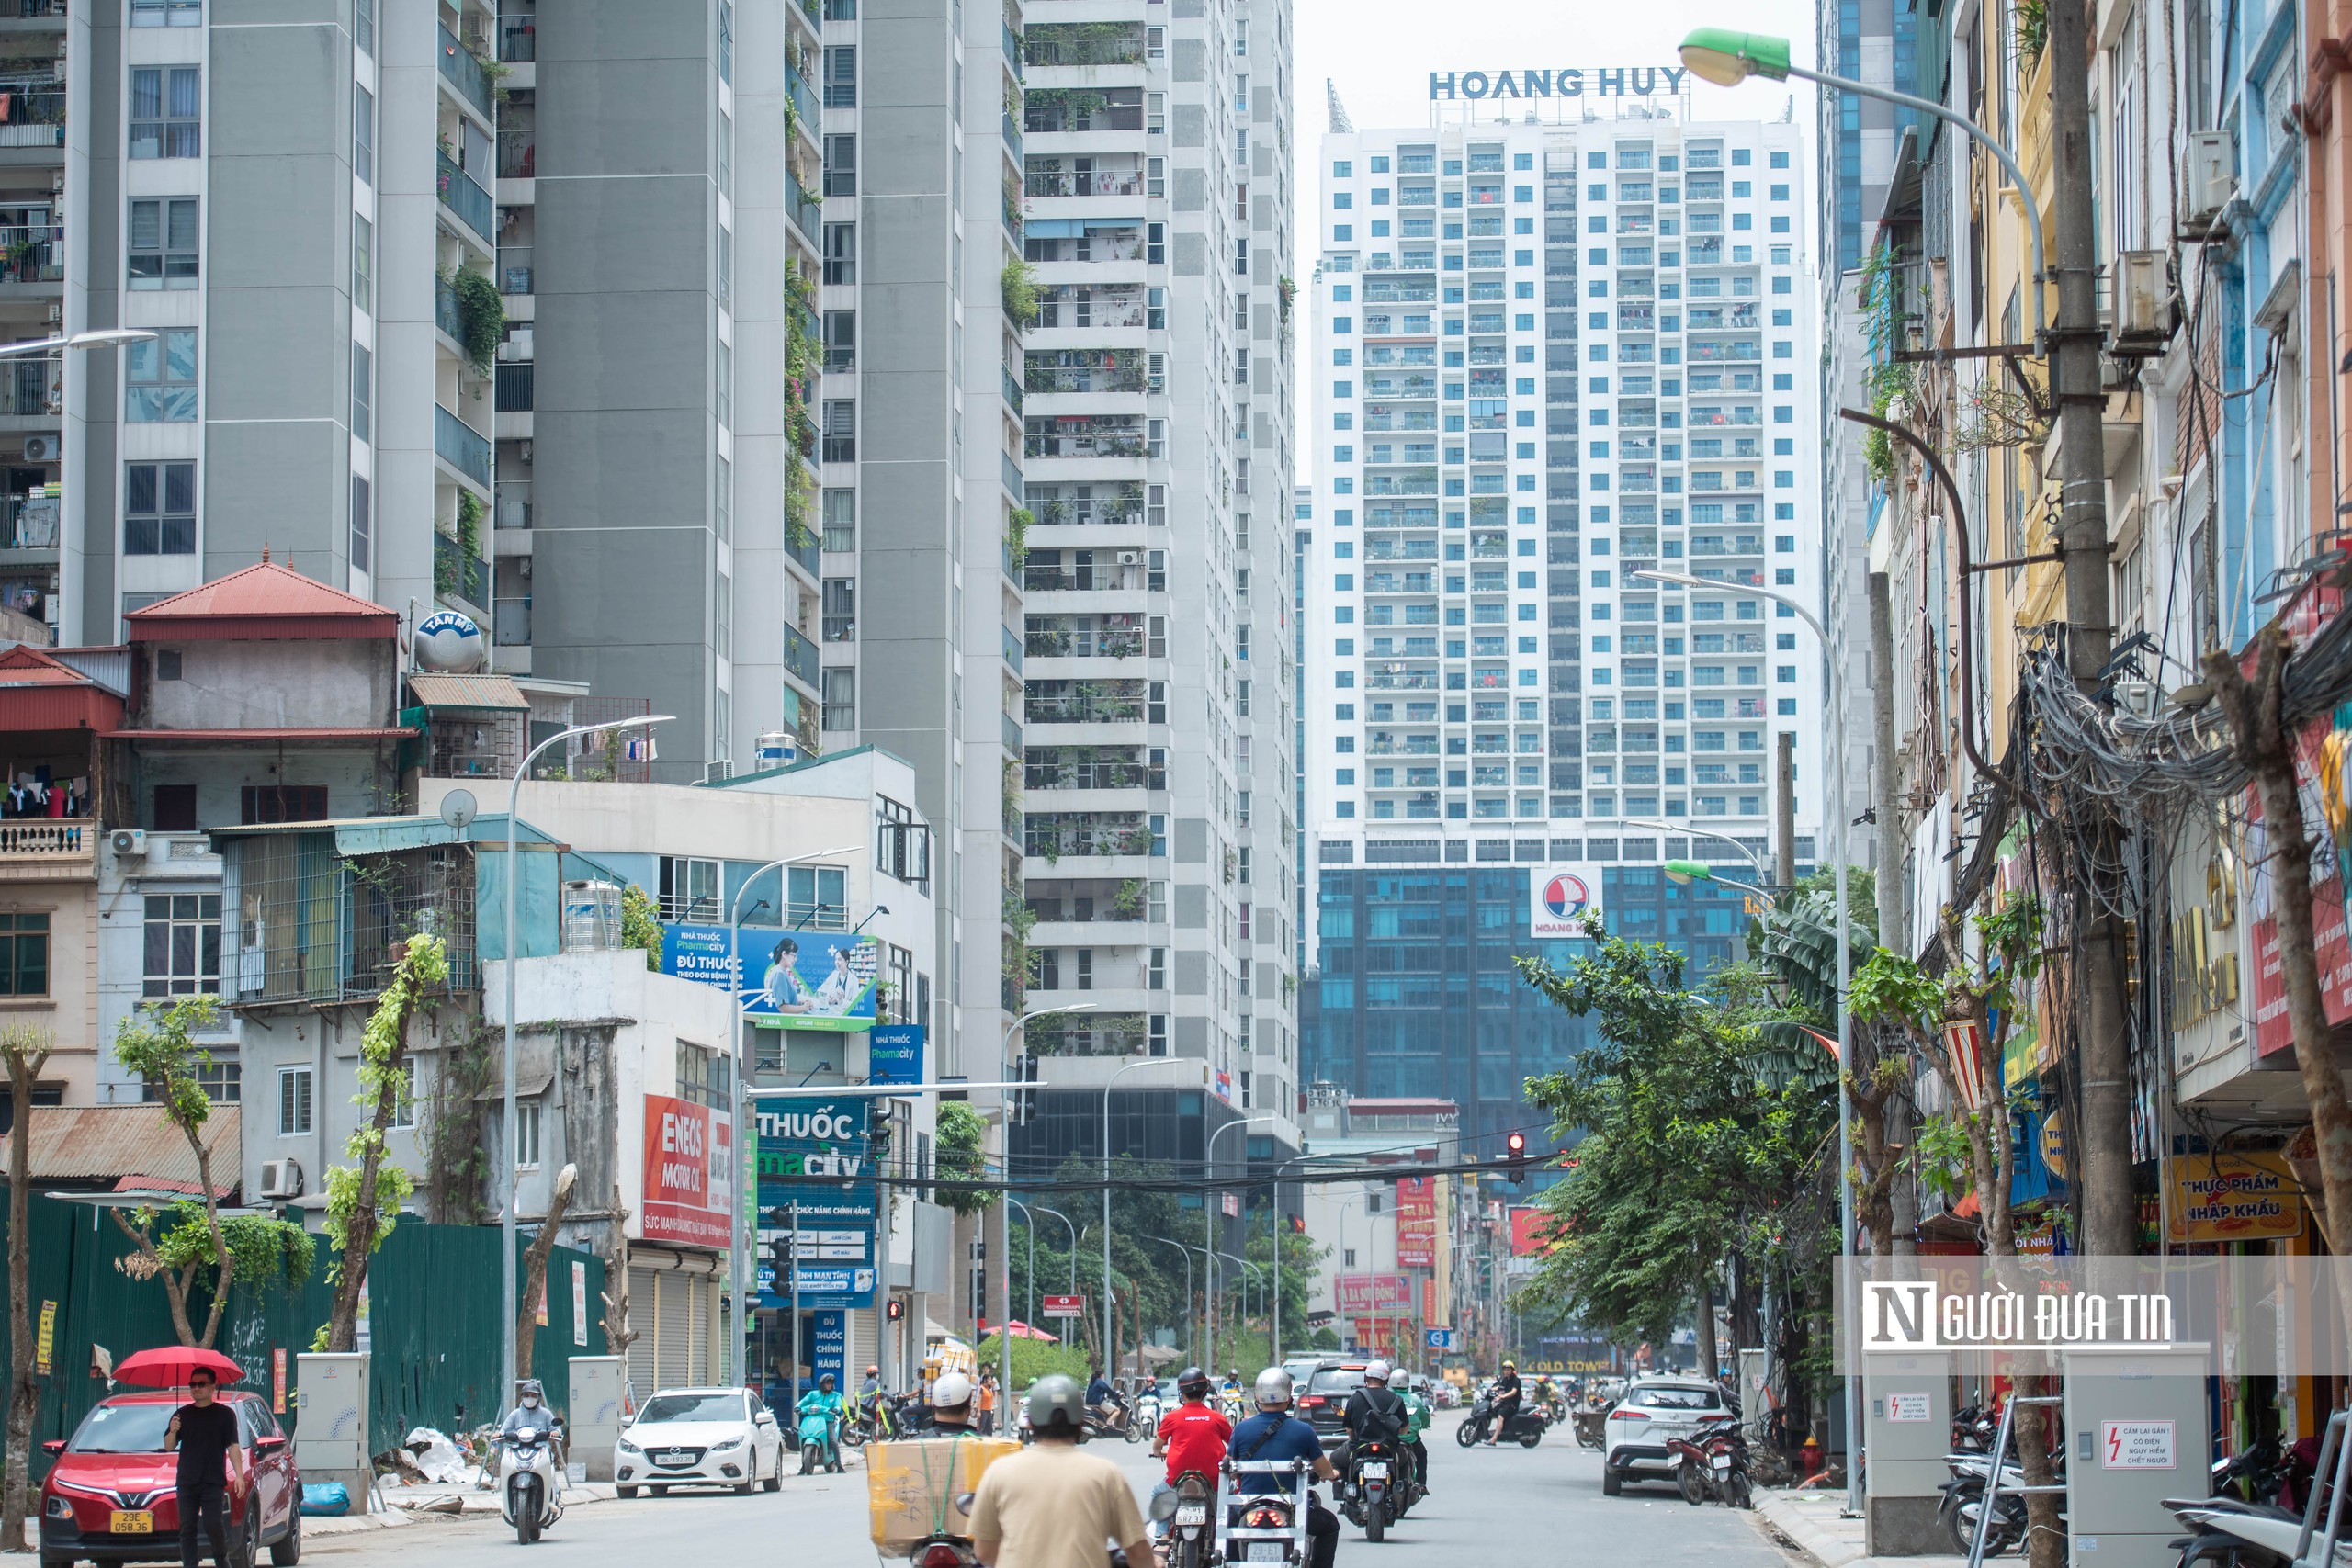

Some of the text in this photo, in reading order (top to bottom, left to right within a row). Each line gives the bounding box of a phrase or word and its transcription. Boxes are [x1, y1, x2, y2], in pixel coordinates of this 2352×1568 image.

[1430, 67, 1690, 99] HOANG HUY
[681, 931, 721, 942] NHÀ THUỐC
[676, 940, 725, 953] Pharmacity
[676, 952, 696, 969] ĐỦ
[876, 1033, 910, 1044] NHÀ THUỐC
[871, 1046, 914, 1061] Pharmacity
[756, 1105, 853, 1140] THUỐC
[1435, 1113, 1457, 1123] IVY
[662, 1112, 703, 1158] ENEOS
[662, 1162, 691, 1191] MOTOR
[691, 1167, 701, 1193] OIL
[2181, 1171, 2279, 1198] THỰC PHẨM
[832, 1205, 853, 1214] CHÍNH
[1418, 1203, 1431, 1216] BA
[2184, 1197, 2281, 1224] NHẬP KHẨU
[645, 1212, 660, 1230] SỨC
[660, 1216, 677, 1234] MẠNH
[823, 1315, 835, 1326] ĐỦ
[816, 1329, 843, 1340] THUỐC
[816, 1343, 842, 1353] CHÍNH
[2123, 1426, 2138, 1435] CẤM
[2151, 1426, 2166, 1435] GẦN
[2144, 1438, 2161, 1446] ĐIỆN
[2148, 1446, 2165, 1454] HIỂM
[2127, 1456, 2145, 1464] CHẾT
[122, 1513, 141, 1522] 29E
[115, 1522, 148, 1532] 058.36
